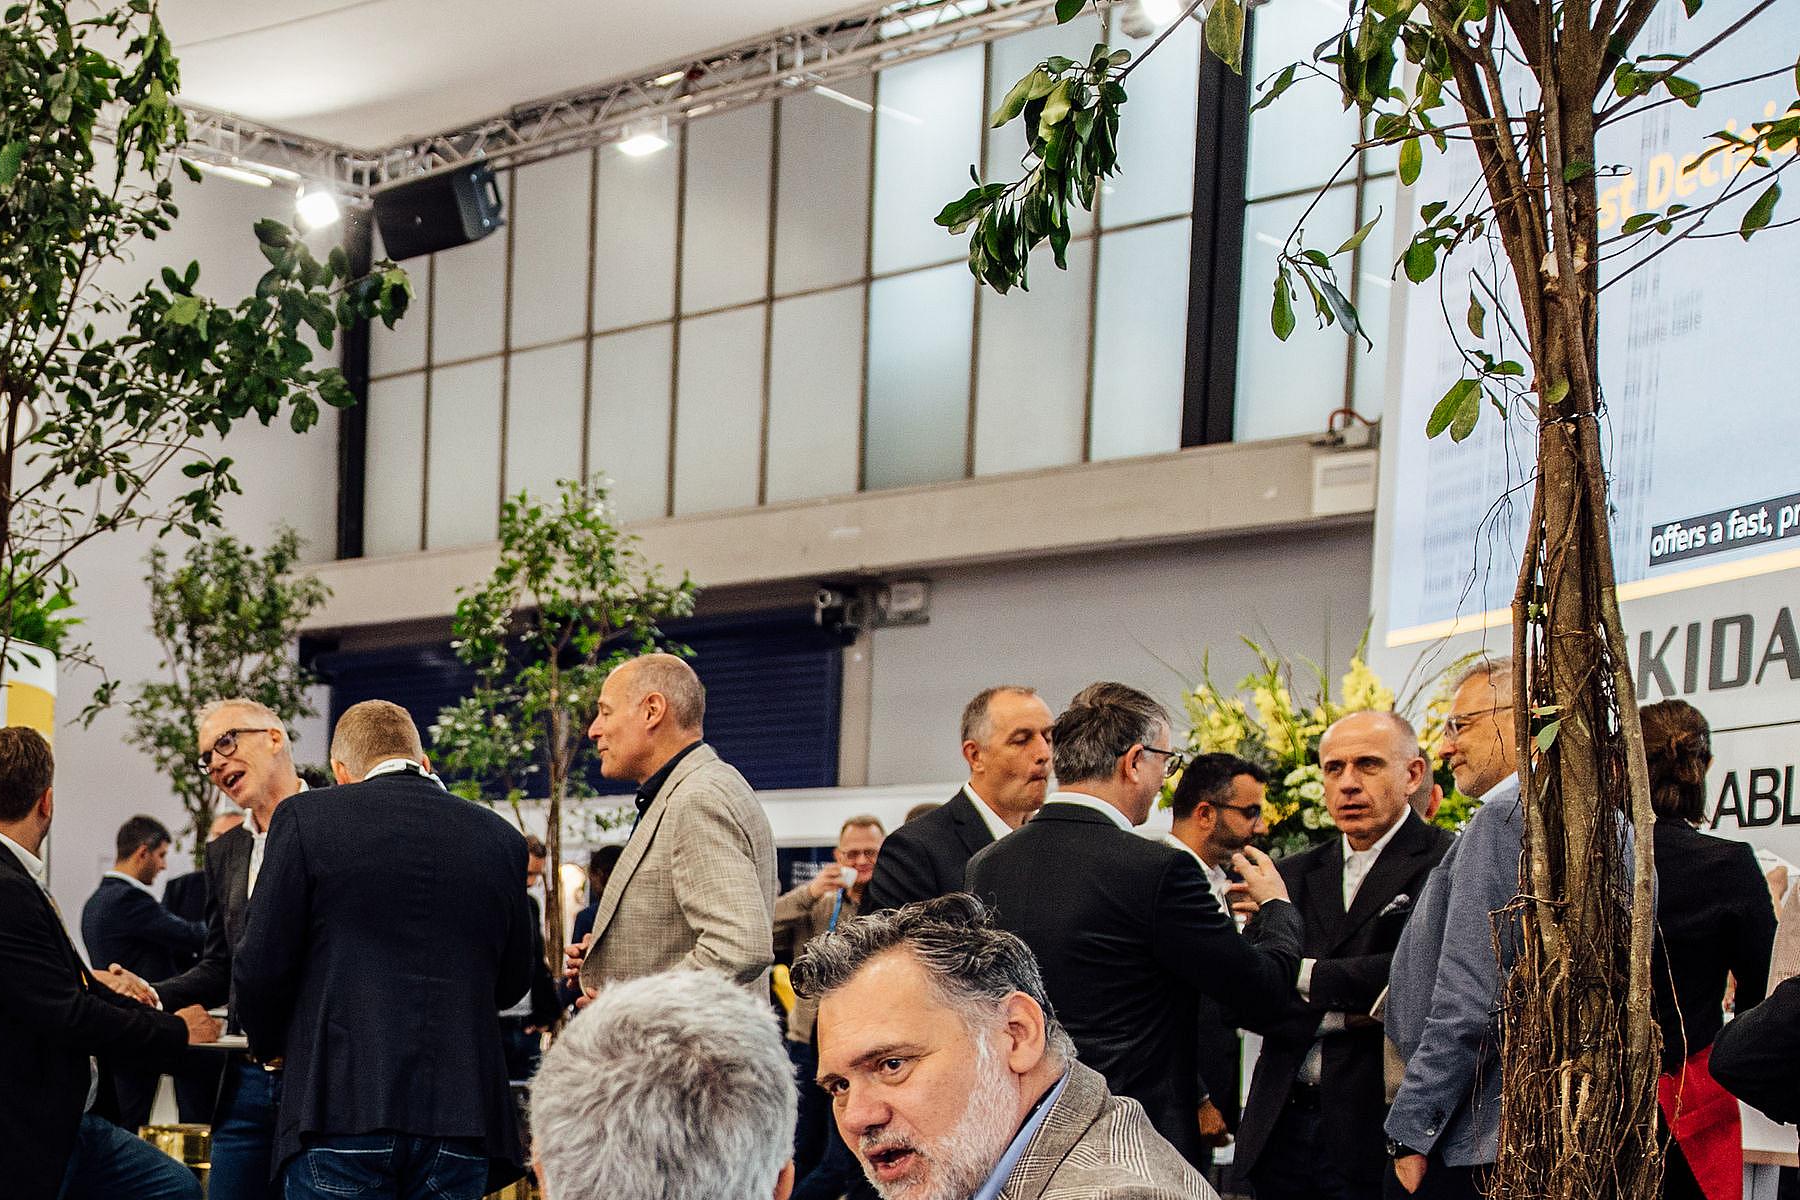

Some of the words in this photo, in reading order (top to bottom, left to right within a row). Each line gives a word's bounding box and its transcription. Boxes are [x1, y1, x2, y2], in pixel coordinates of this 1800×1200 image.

[1651, 522, 1706, 558] offers
[1708, 520, 1725, 545] a
[1726, 506, 1773, 542] fast,
[1636, 606, 1800, 701] KIDA
